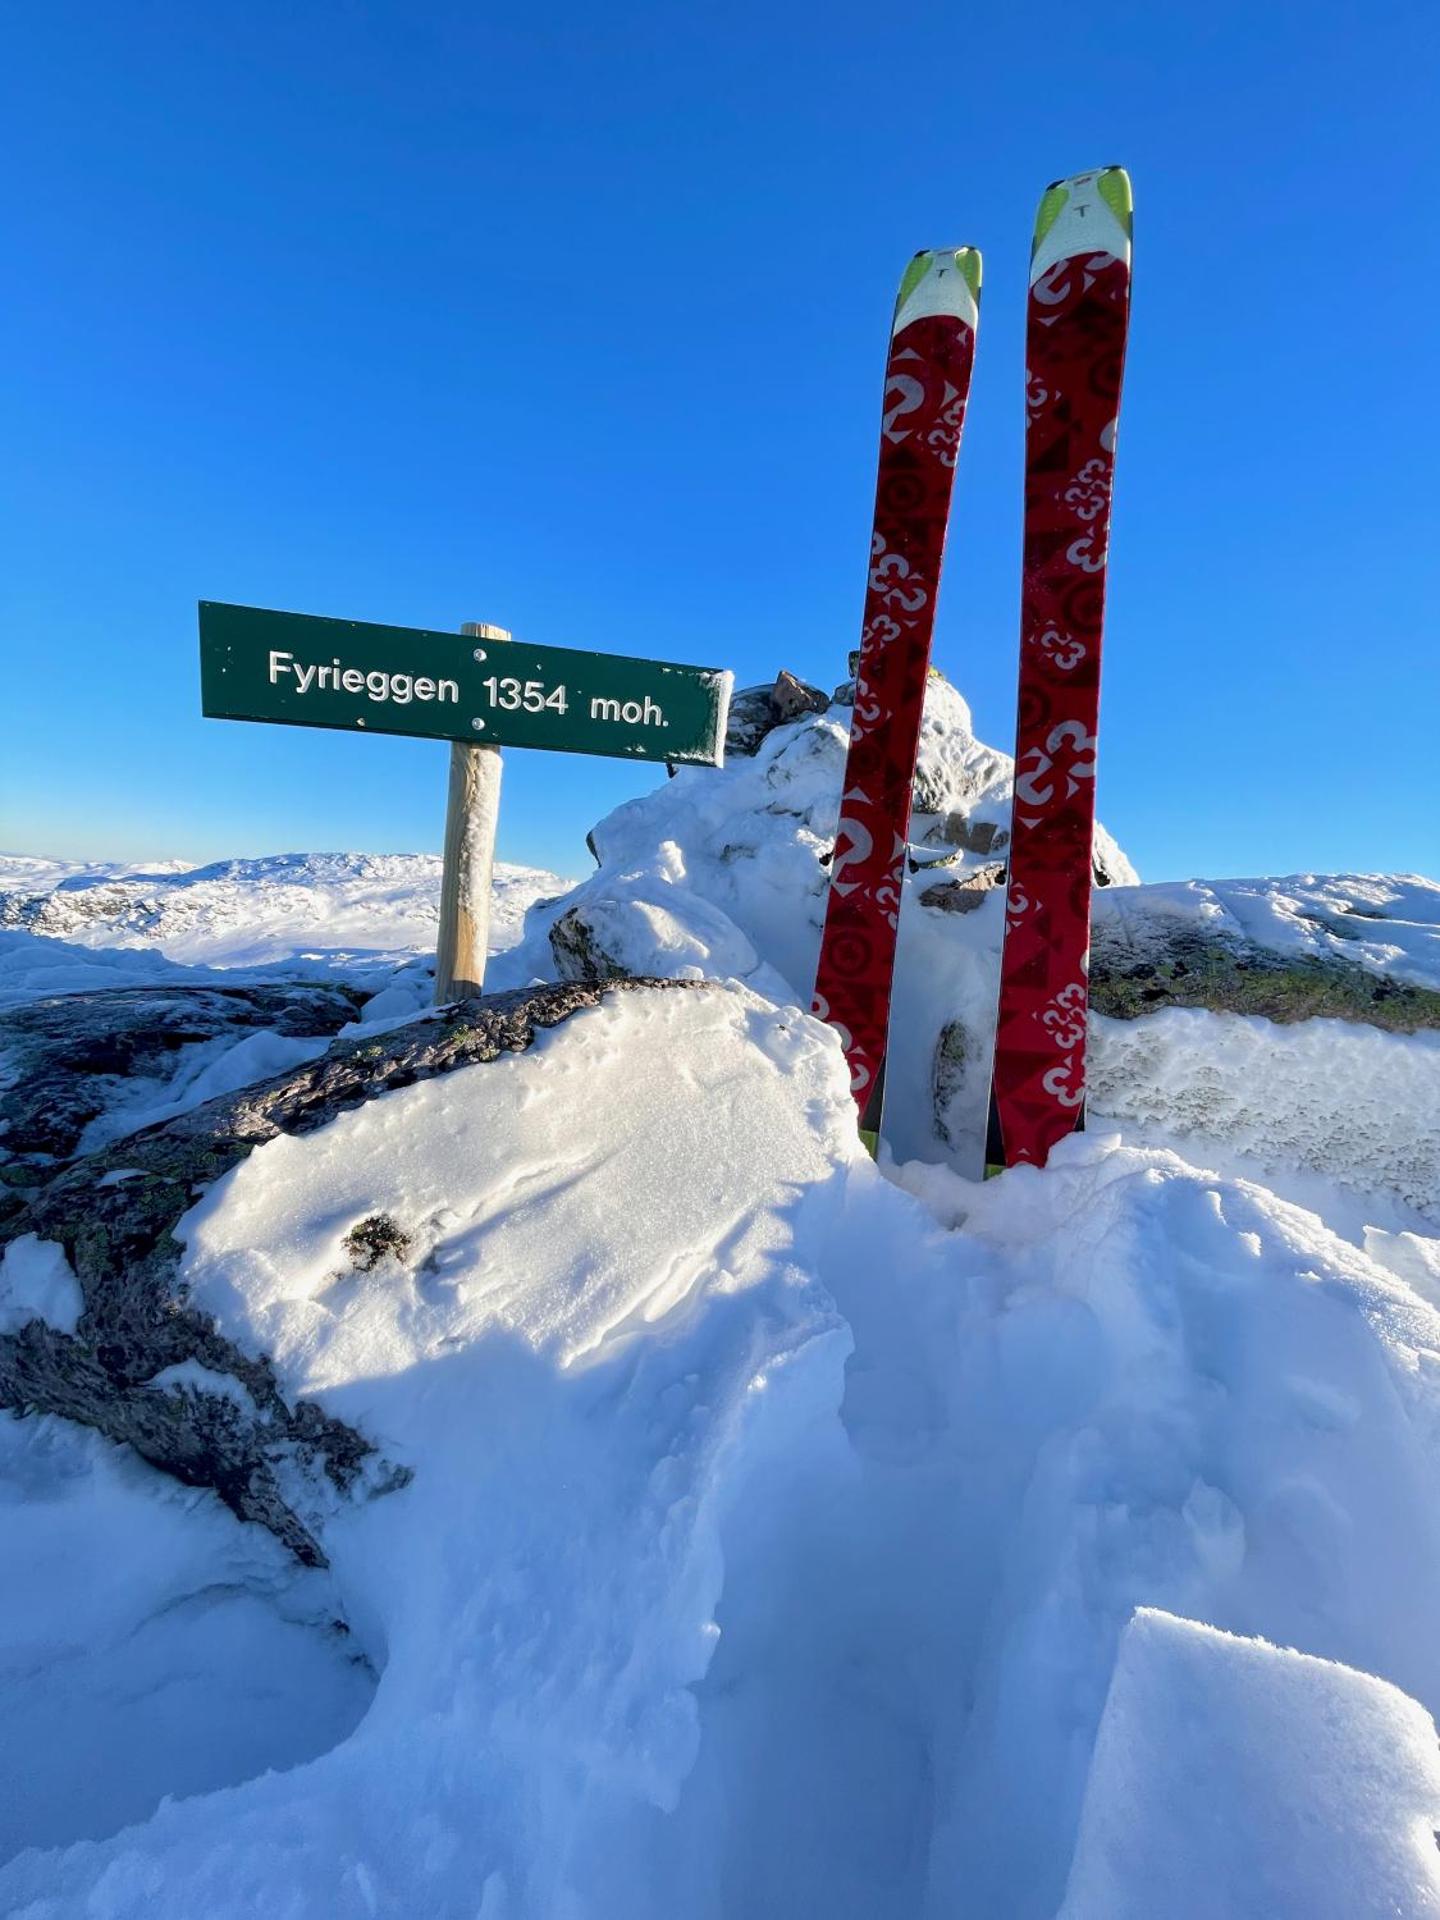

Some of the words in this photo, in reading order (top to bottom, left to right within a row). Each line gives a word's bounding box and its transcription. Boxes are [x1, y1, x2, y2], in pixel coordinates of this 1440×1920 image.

[269, 650, 460, 704] Fyrieggen
[482, 676, 569, 715] 1354
[591, 695, 669, 727] moh.
